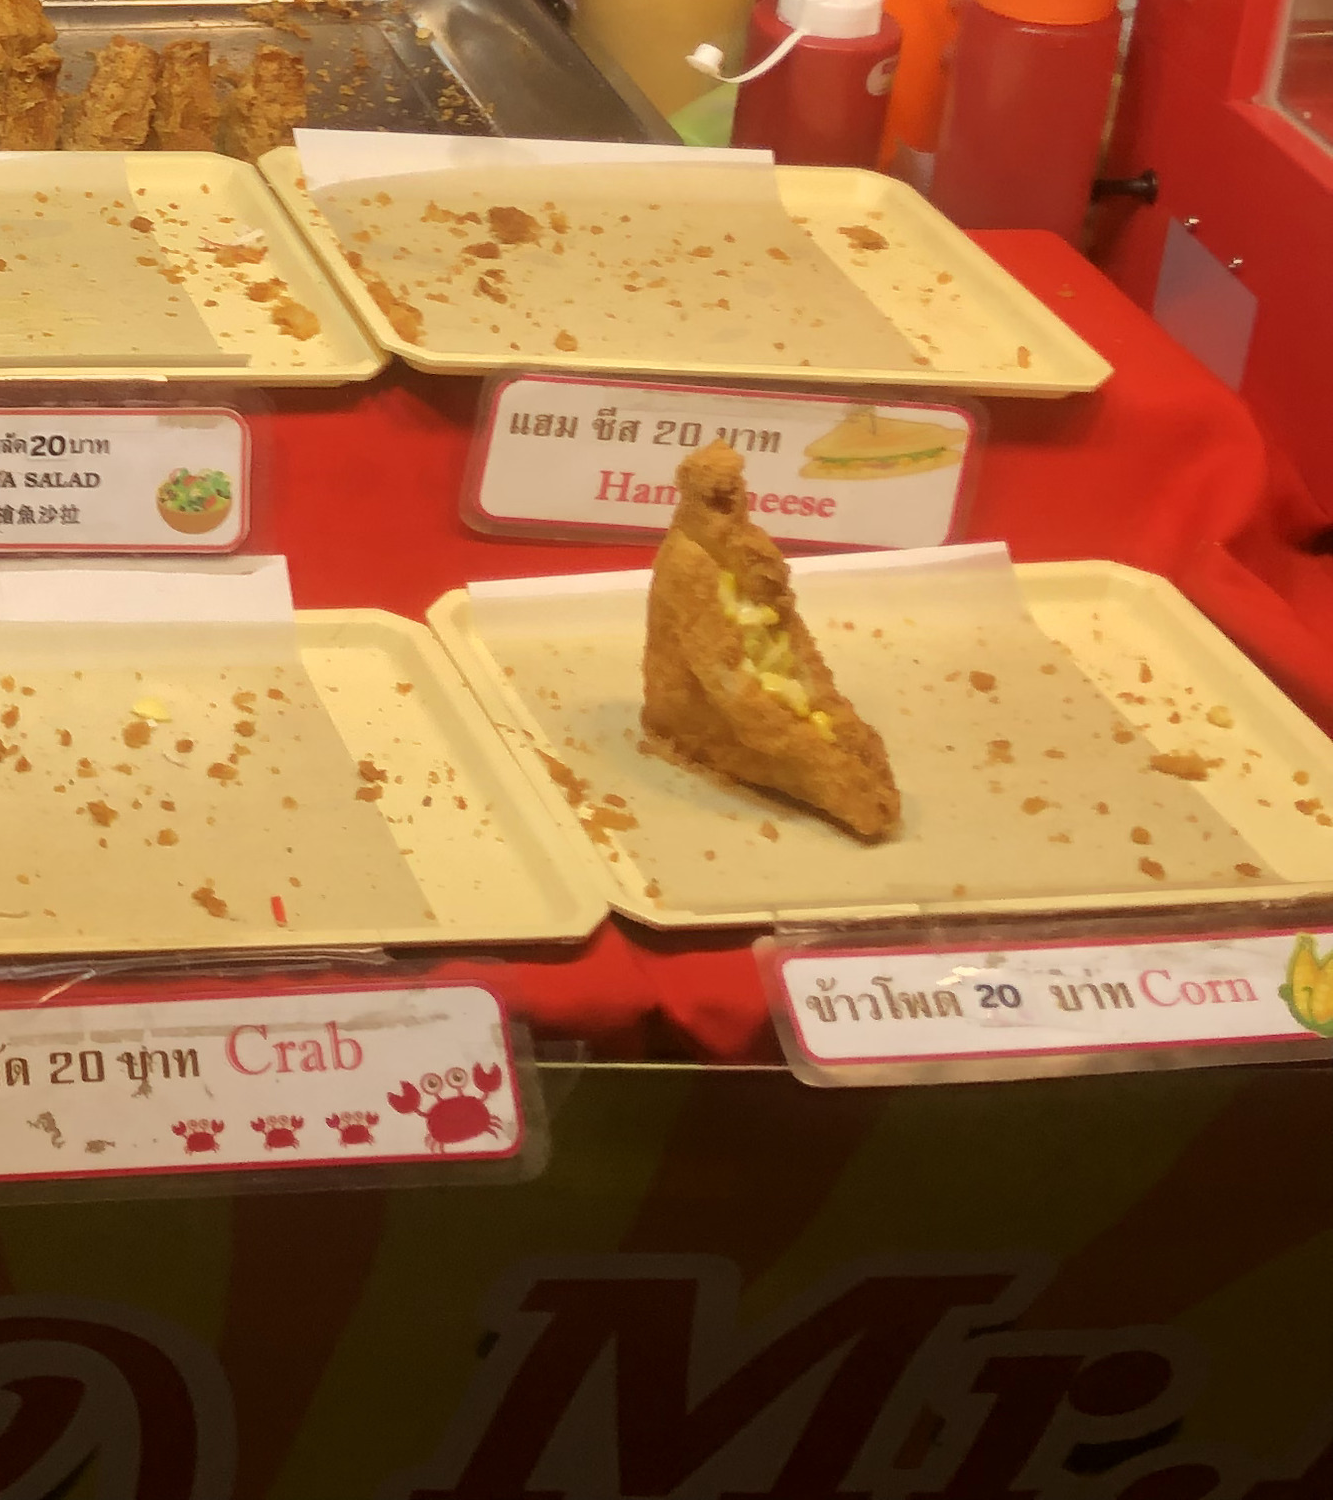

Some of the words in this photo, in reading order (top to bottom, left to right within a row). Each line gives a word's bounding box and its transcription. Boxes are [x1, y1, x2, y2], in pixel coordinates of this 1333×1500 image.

[30, 434, 67, 457] 20
[68, 437, 111, 455] บาท
[508, 410, 579, 439] แฮม
[592, 406, 642, 443] ชีส
[652, 418, 703, 448] 20
[23, 472, 102, 489] SALAD
[805, 974, 965, 1024] ข้าวโพด
[974, 982, 1023, 1010] 20
[1049, 978, 1136, 1012] บาท
[1137, 969, 1259, 1008] Corn
[48, 1049, 106, 1085] 20
[121, 1047, 202, 1082] บาท
[223, 1020, 365, 1077] Crab
